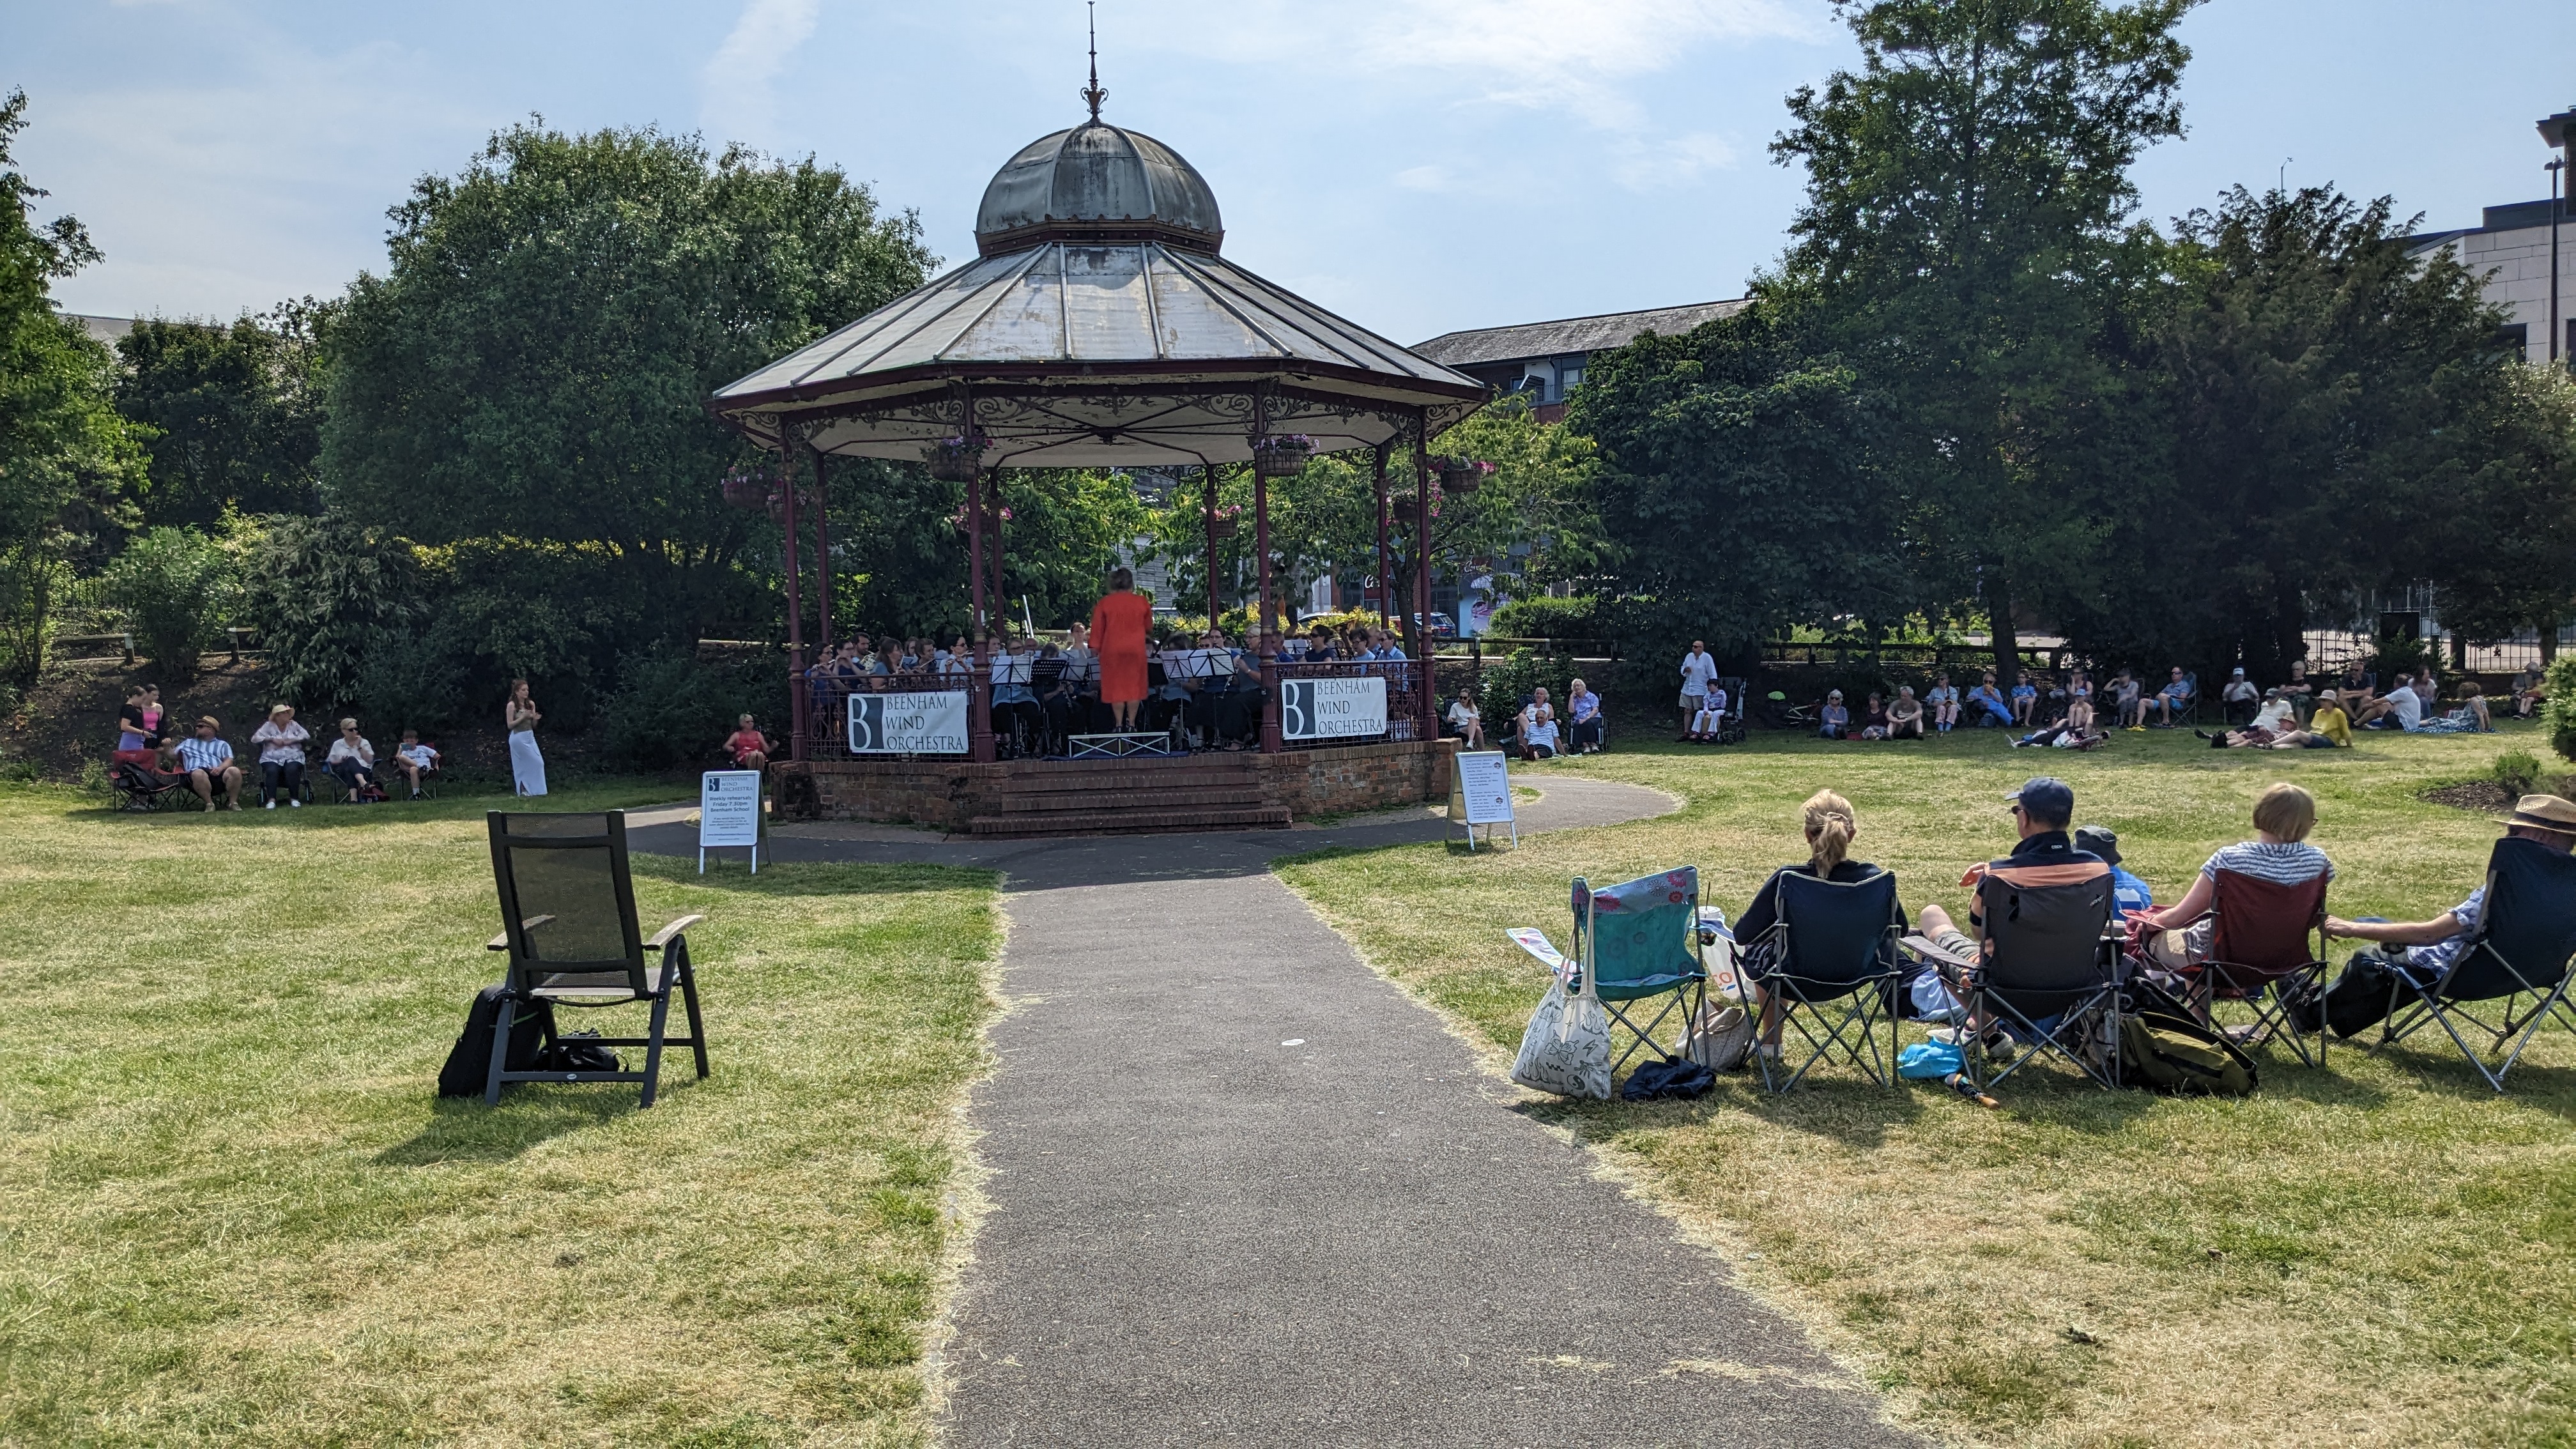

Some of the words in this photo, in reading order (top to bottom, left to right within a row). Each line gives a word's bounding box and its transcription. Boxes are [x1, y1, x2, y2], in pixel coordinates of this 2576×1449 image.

[1317, 680, 1370, 695] BEENHAM
[887, 695, 947, 710] BEENHAM
[1317, 700, 1350, 715] WIND
[885, 716, 924, 730] WIND
[1319, 718, 1383, 735] ORCHESTRA
[887, 736, 964, 750] ORCHESTRA
